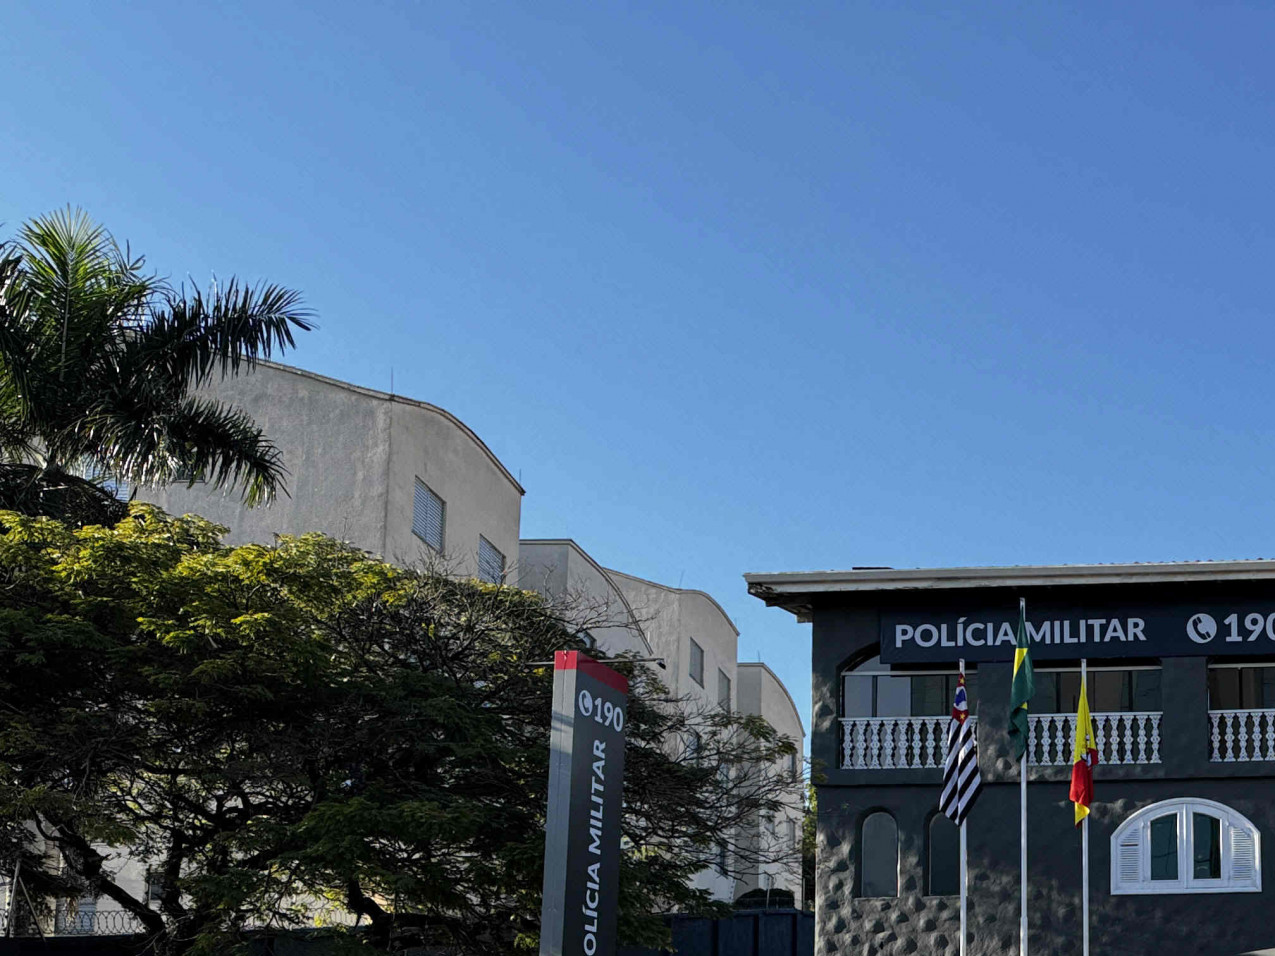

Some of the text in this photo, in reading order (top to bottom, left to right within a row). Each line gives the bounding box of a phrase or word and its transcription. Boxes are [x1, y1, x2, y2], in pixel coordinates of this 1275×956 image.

[895, 617, 1147, 648] POLÍCIA MILITAR
[594, 697, 624, 732] 190
[588, 739, 607, 855] MILITAR
